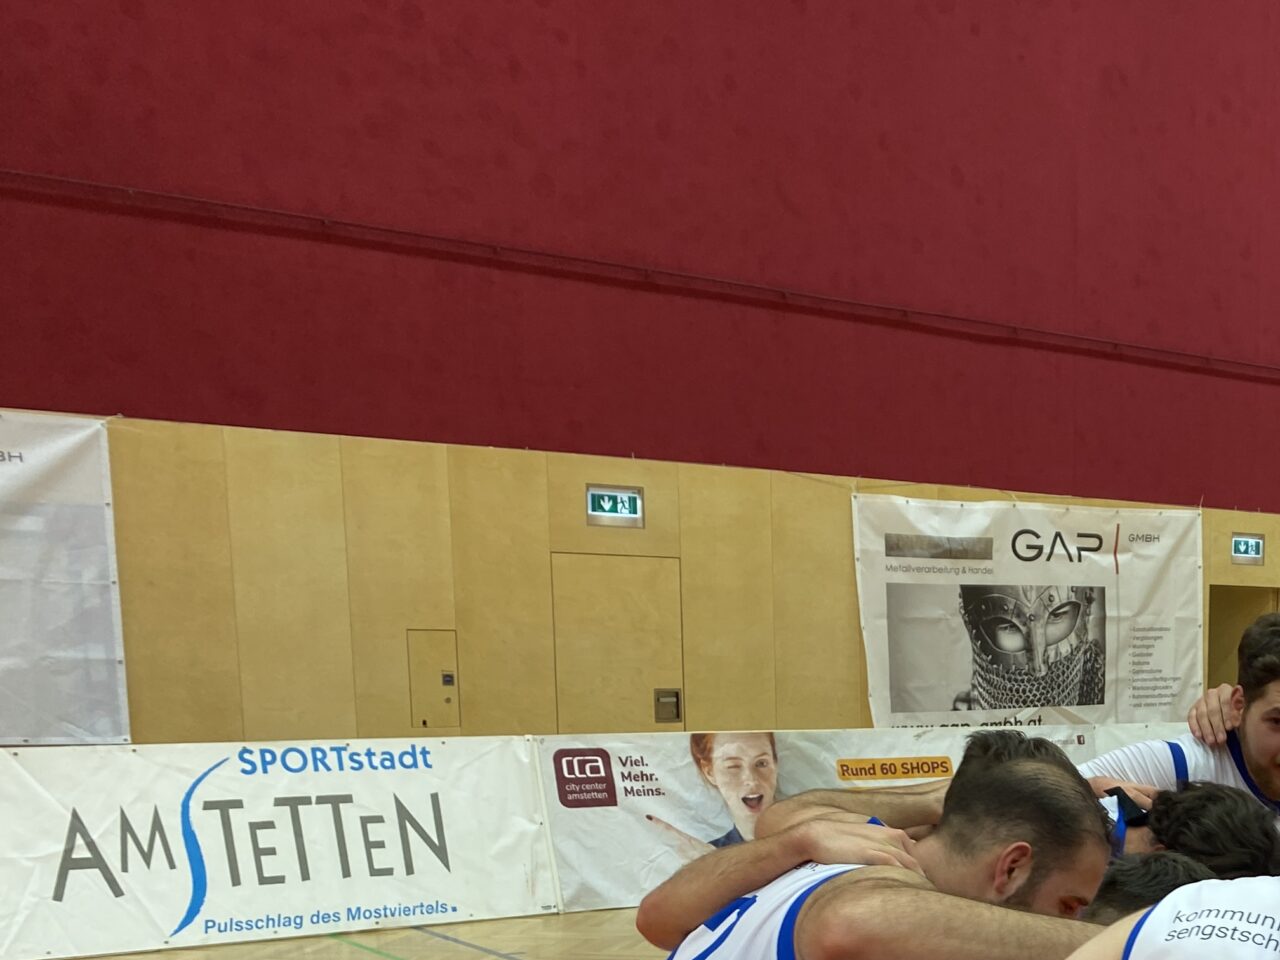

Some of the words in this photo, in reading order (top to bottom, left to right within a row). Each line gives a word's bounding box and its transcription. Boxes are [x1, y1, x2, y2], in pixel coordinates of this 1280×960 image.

[1128, 532, 1161, 544] GMBH
[1011, 528, 1103, 563] GAP
[237, 744, 433, 776] SPORTstadt
[618, 756, 649, 768] Viel.
[840, 763, 876, 777] Rund
[880, 762, 897, 776] 60
[901, 760, 949, 775] SHOPS
[620, 770, 659, 783] Mehr.
[565, 782, 580, 793] city
[581, 782, 607, 791] center
[623, 785, 666, 798] Meins.
[567, 791, 608, 801] amstetten
[203, 913, 304, 935] Pulsschlag
[310, 909, 342, 925] des
